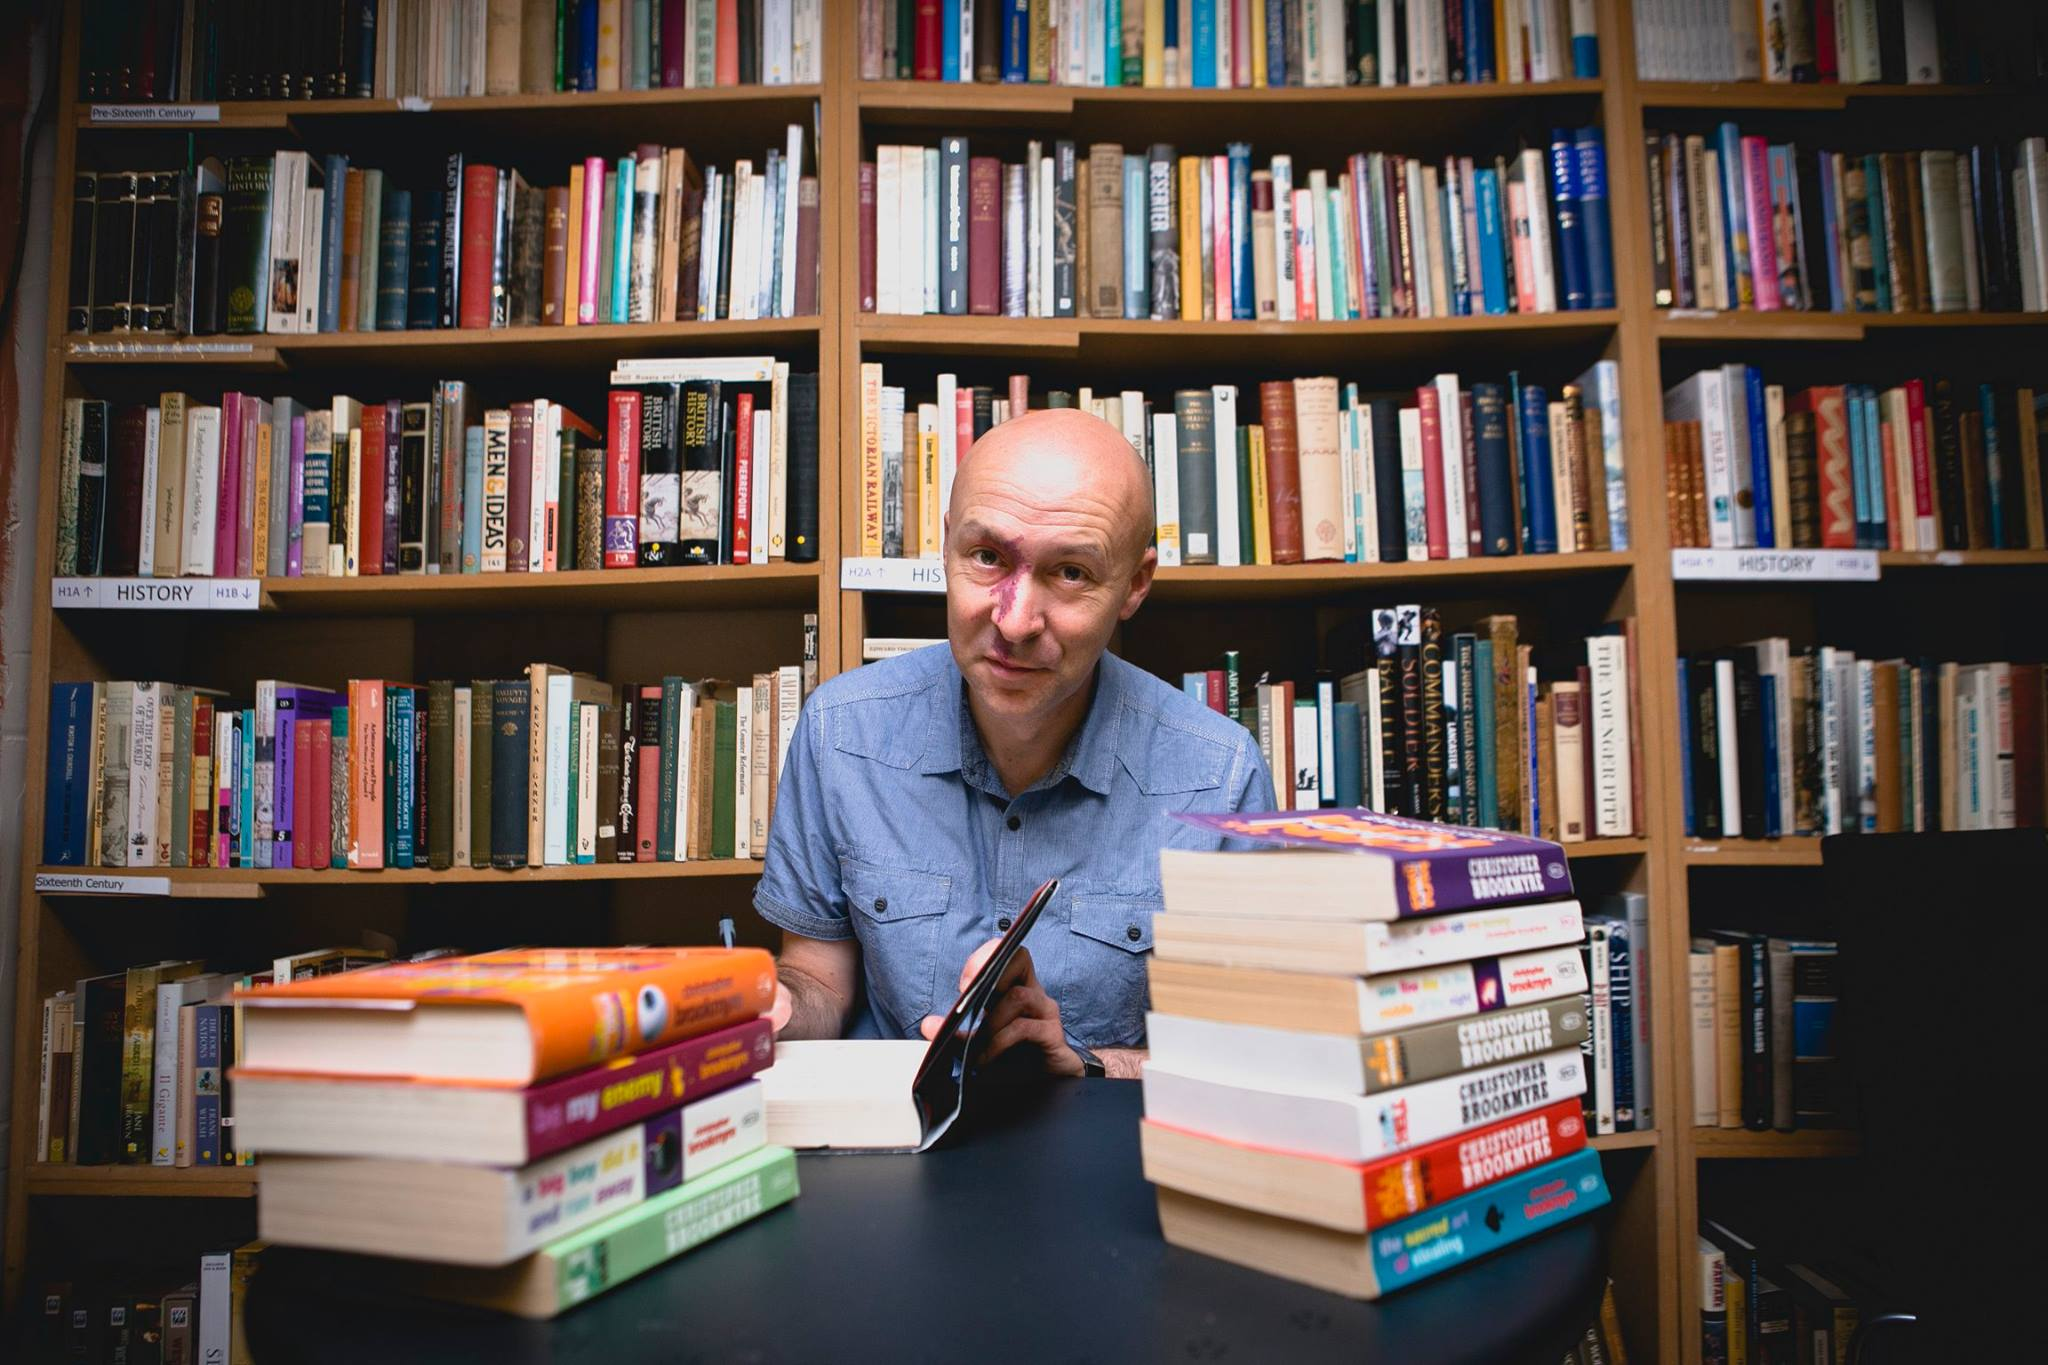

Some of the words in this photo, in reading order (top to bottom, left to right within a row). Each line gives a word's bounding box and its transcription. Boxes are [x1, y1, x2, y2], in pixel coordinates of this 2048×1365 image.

[93, 108, 156, 119] Pre-Sixteenth
[159, 108, 196, 120] Century
[1150, 161, 1170, 232] DESERTER
[867, 380, 877, 404] THE
[642, 395, 655, 450] HISTORY
[651, 396, 664, 449] BRITISH
[686, 392, 697, 448] HISTORY
[695, 392, 707, 446] BRITISH
[486, 430, 506, 477] MEN
[866, 408, 877, 478] VICTORIAN
[926, 438, 934, 452] Lion
[486, 478, 505, 494] &
[924, 454, 934, 484] Rampant
[736, 459, 748, 520] PIERREPOINT
[484, 494, 504, 550] IDEAS
[866, 480, 878, 541] RAILWAY
[849, 568, 872, 577] H2A
[1739, 555, 1816, 572] HISTORY
[58, 587, 80, 597] H1A
[117, 584, 194, 602] HISTORY
[216, 587, 238, 598] H1B
[1461, 644, 1472, 666] THE
[1598, 644, 1612, 682] THE
[1229, 669, 1239, 706] ABOVE
[1462, 668, 1473, 712] JUBILEE
[136, 705, 144, 717] OF
[136, 720, 144, 736] THE
[144, 697, 154, 722] OVER
[740, 716, 748, 728] The
[1262, 704, 1270, 722] THE
[1402, 658, 1420, 774] SOLDIER
[144, 723, 153, 742] THE
[368, 722, 377, 764] Aristocracy
[532, 705, 540, 763] KENTISH
[570, 720, 578, 774] RENAISSANCE
[1262, 726, 1270, 756] ELDER
[1423, 643, 1442, 816] COMMANDERS
[1447, 722, 1458, 770] LANCASTER
[1464, 714, 1474, 748] YEARS
[1600, 689, 1614, 780] YOUNGER
[134, 738, 144, 766] WORLD
[144, 745, 153, 770] EDGE
[368, 780, 376, 802] People
[739, 756, 747, 796] Reformation
[402, 800, 410, 830] SOCIETY
[1604, 784, 1617, 830] PITT
[36, 877, 82, 888] Sixteenth
[85, 878, 124, 891] Century
[1468, 854, 1540, 878] CHRISTOPHER
[1471, 872, 1544, 900] BROOKMYRE
[1508, 976, 1552, 994] brookmyre
[1512, 966, 1544, 978] christopher
[1610, 952, 1630, 1007] SHIP
[135, 985, 144, 1024] PURSUIT
[674, 993, 744, 1028] brookmyre
[199, 1018, 208, 1058] NATIONS
[208, 1017, 216, 1034] THE
[1458, 1008, 1552, 1046] CHRISTOPHER
[208, 1036, 216, 1058] FOUR
[1461, 1028, 1553, 1068] BROOKMYRE
[564, 1092, 599, 1124] my
[601, 1070, 664, 1112] enemy
[1459, 1062, 1547, 1101] CHRISTOPHER
[124, 1104, 134, 1138] BROWN
[157, 1088, 168, 1133] Gigante
[1461, 1081, 1550, 1125] BROOKMYRE
[134, 1112, 142, 1132] JANE
[198, 1108, 208, 1138] WELSH
[208, 1108, 217, 1136] FRANK
[1459, 1116, 1550, 1166] CHRISTOPHER
[1461, 1136, 1553, 1188] BROOKMYRE
[667, 1194, 762, 1254] BROOKMYRE
[1404, 1218, 1449, 1247] sacred
[1712, 1260, 1723, 1309] WARFARE
